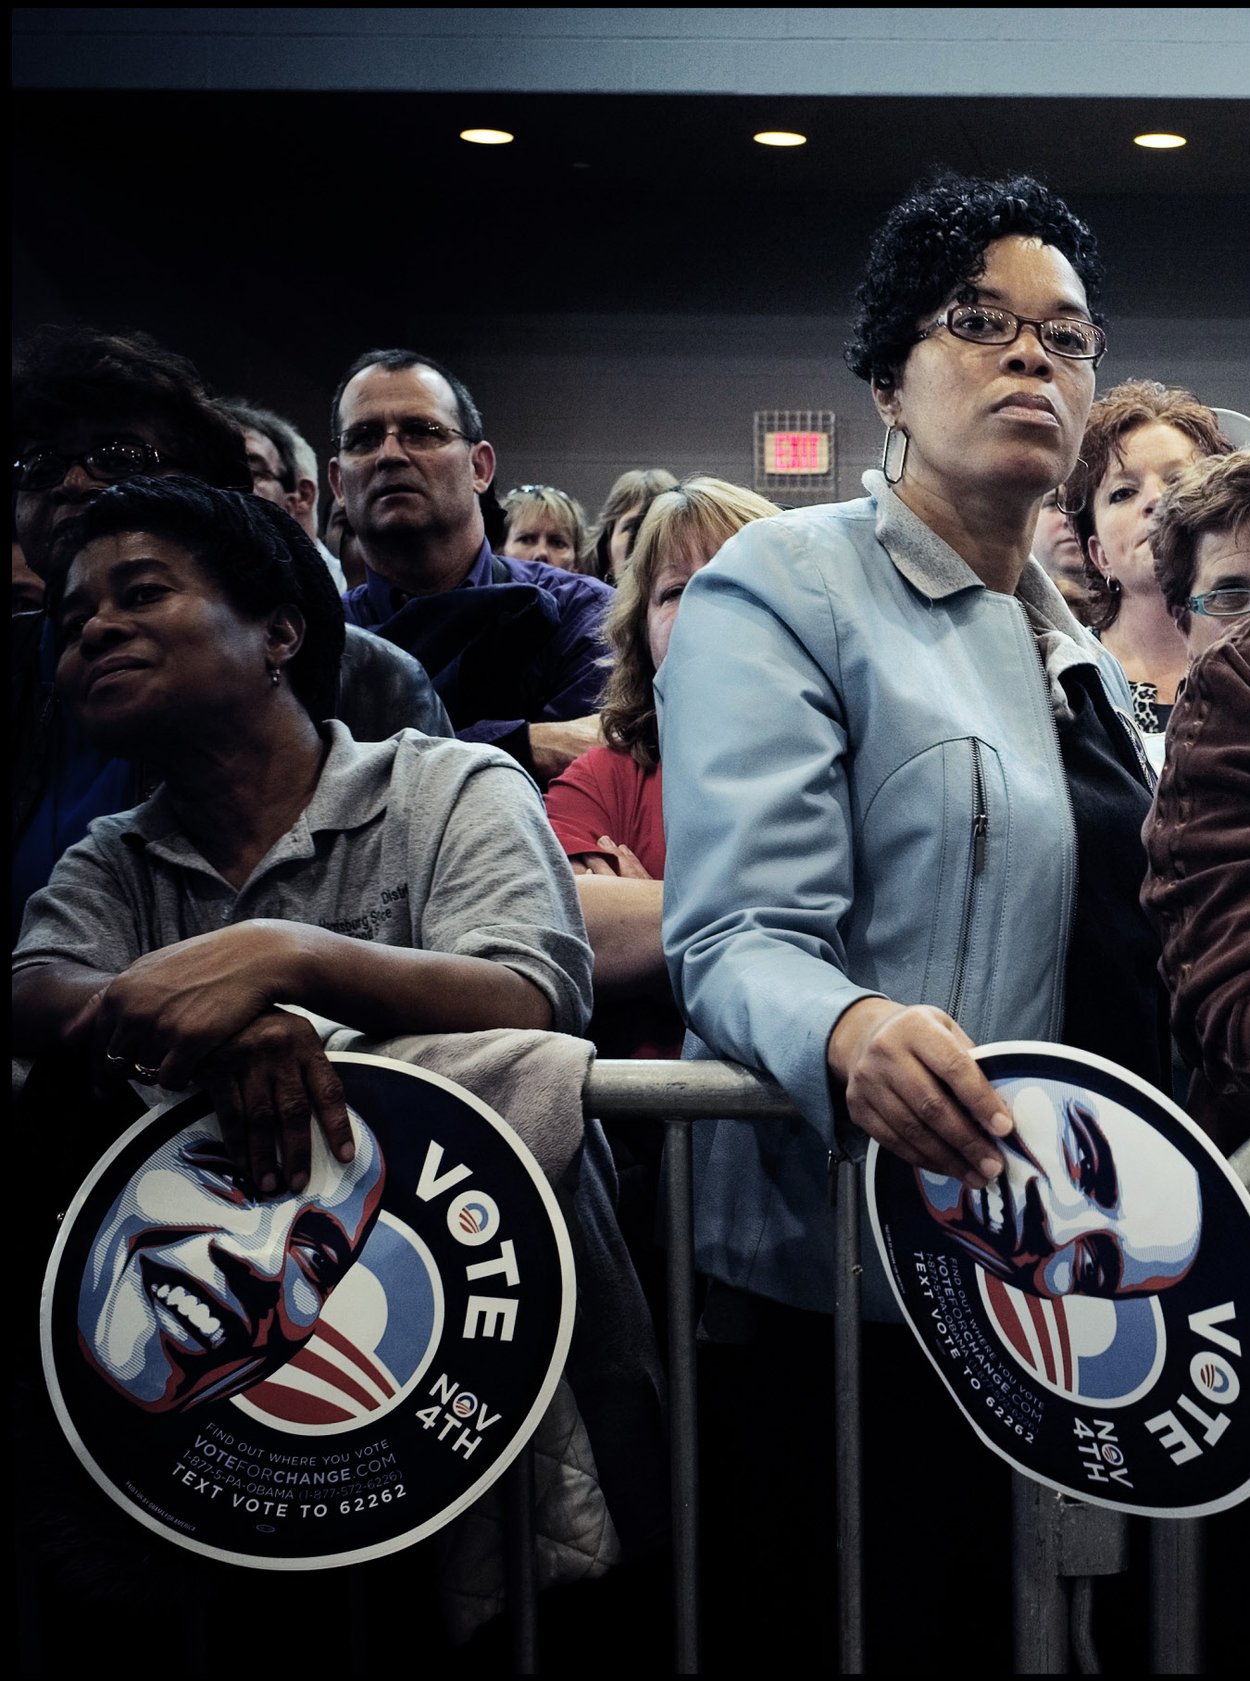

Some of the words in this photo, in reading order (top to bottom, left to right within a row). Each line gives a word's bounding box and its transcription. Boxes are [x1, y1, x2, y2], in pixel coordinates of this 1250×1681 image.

[775, 432, 820, 469] EXIT
[415, 1138, 521, 1342] VOTE
[913, 1251, 934, 1299] TEXT
[931, 1308, 961, 1359] VOTE
[963, 1366, 981, 1390] TO
[985, 1396, 1034, 1443] 62262
[936, 1255, 1042, 1422] VOTEFORCHANGE.COM
[950, 1257, 962, 1286] FIND
[958, 1290, 972, 1315] OUT
[970, 1318, 997, 1360] WHERE
[998, 1361, 1017, 1385] YOU
[1019, 1385, 1045, 1409] VOTE
[428, 1372, 502, 1432] NOV
[1143, 1300, 1243, 1466] VOTE
[194, 1434, 396, 1485] VOTEFORCHANGE.COM
[206, 1422, 235, 1445] FIND
[237, 1442, 265, 1458] OUT
[269, 1451, 317, 1466] WHERE
[322, 1453, 350, 1465] YOU
[355, 1439, 390, 1459] VOTE
[415, 1405, 482, 1461] 4TH
[1072, 1417, 1109, 1482] 4TH
[1093, 1418, 1135, 1489] NOV
[172, 1461, 224, 1499] TEXT
[232, 1493, 289, 1517] VOTE
[300, 1504, 328, 1518] TO
[340, 1484, 407, 1514] 62262
[183, 1449, 294, 1500] 1-877-5-PA-OBAMA
